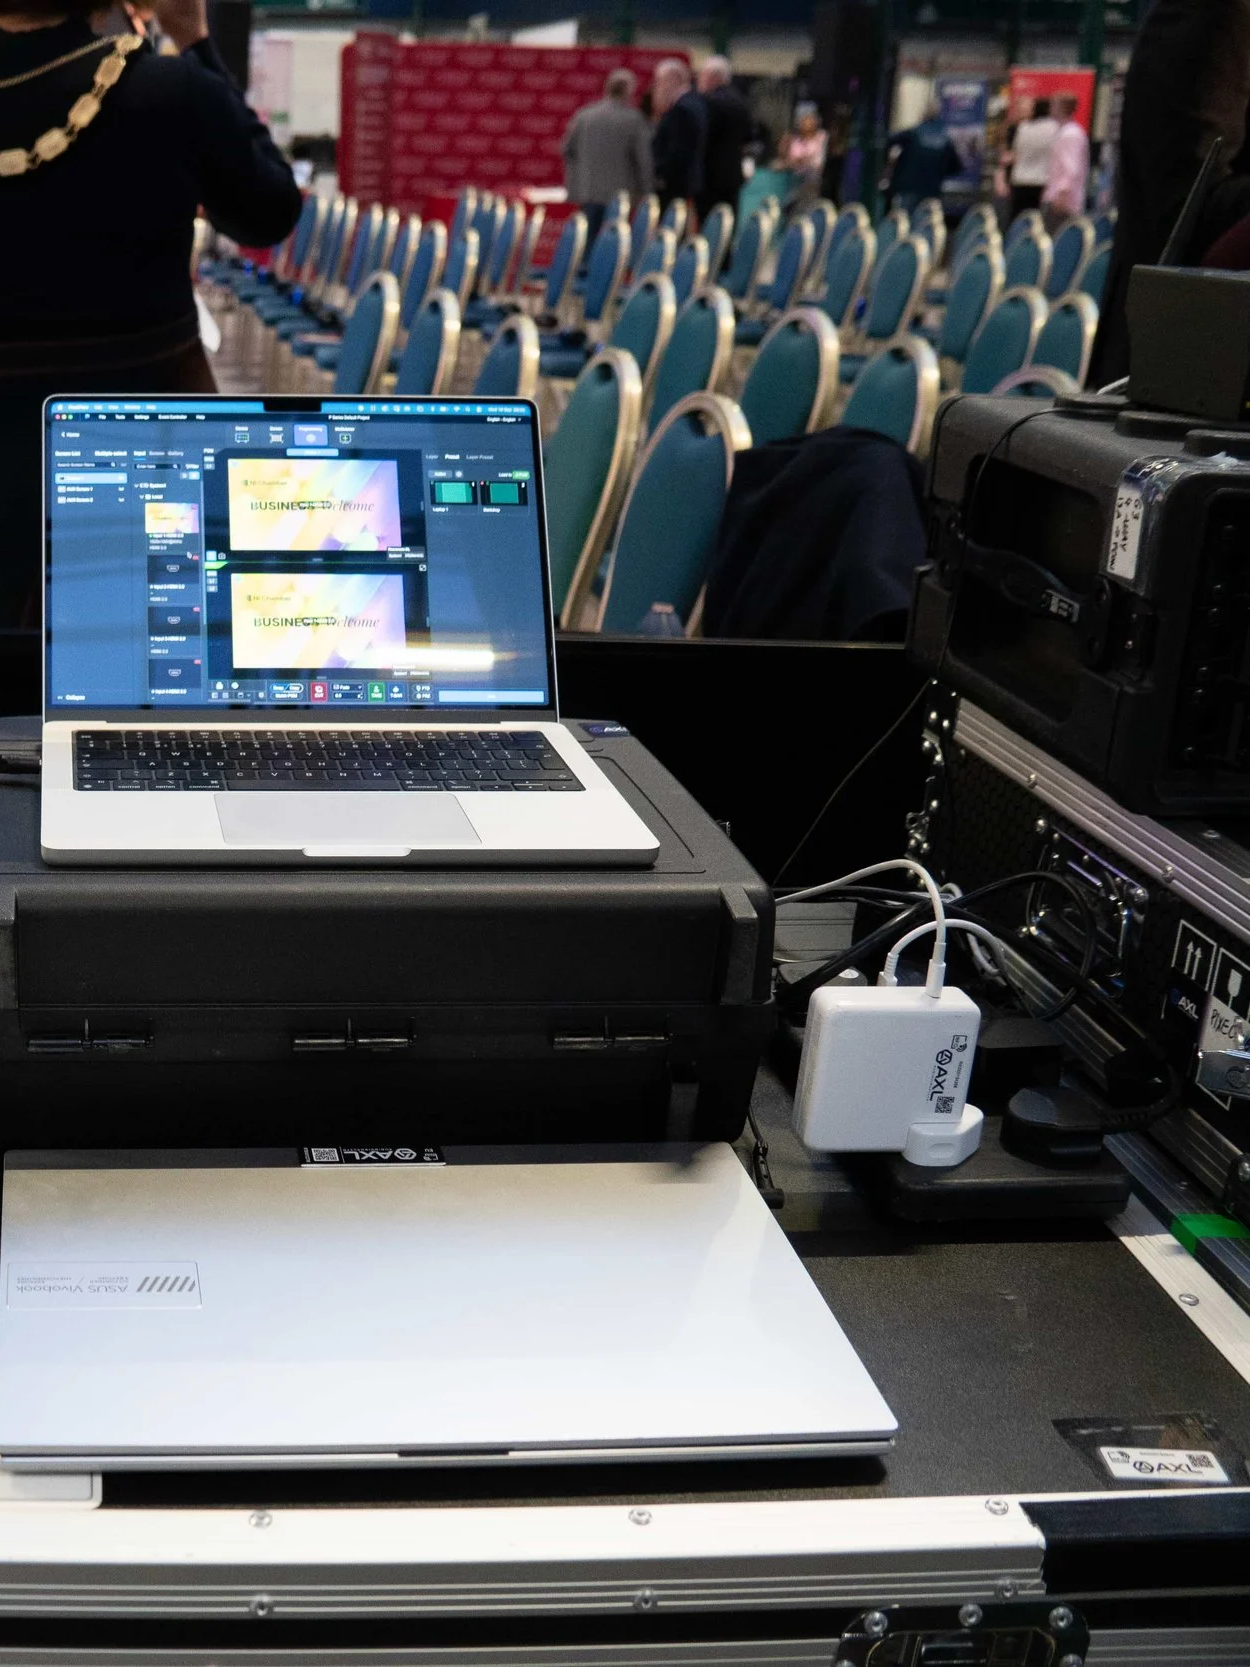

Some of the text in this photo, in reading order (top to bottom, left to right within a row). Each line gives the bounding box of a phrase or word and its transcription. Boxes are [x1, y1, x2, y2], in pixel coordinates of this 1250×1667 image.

[250, 501, 315, 511] BUSINE
[254, 617, 319, 627] BUSINE
[1178, 996, 1199, 1019] AXL
[929, 1065, 948, 1102] AXL
[344, 1150, 393, 1160] AXL
[16, 1284, 128, 1294] ASUS Vivobook
[1156, 1462, 1203, 1475] AXL
